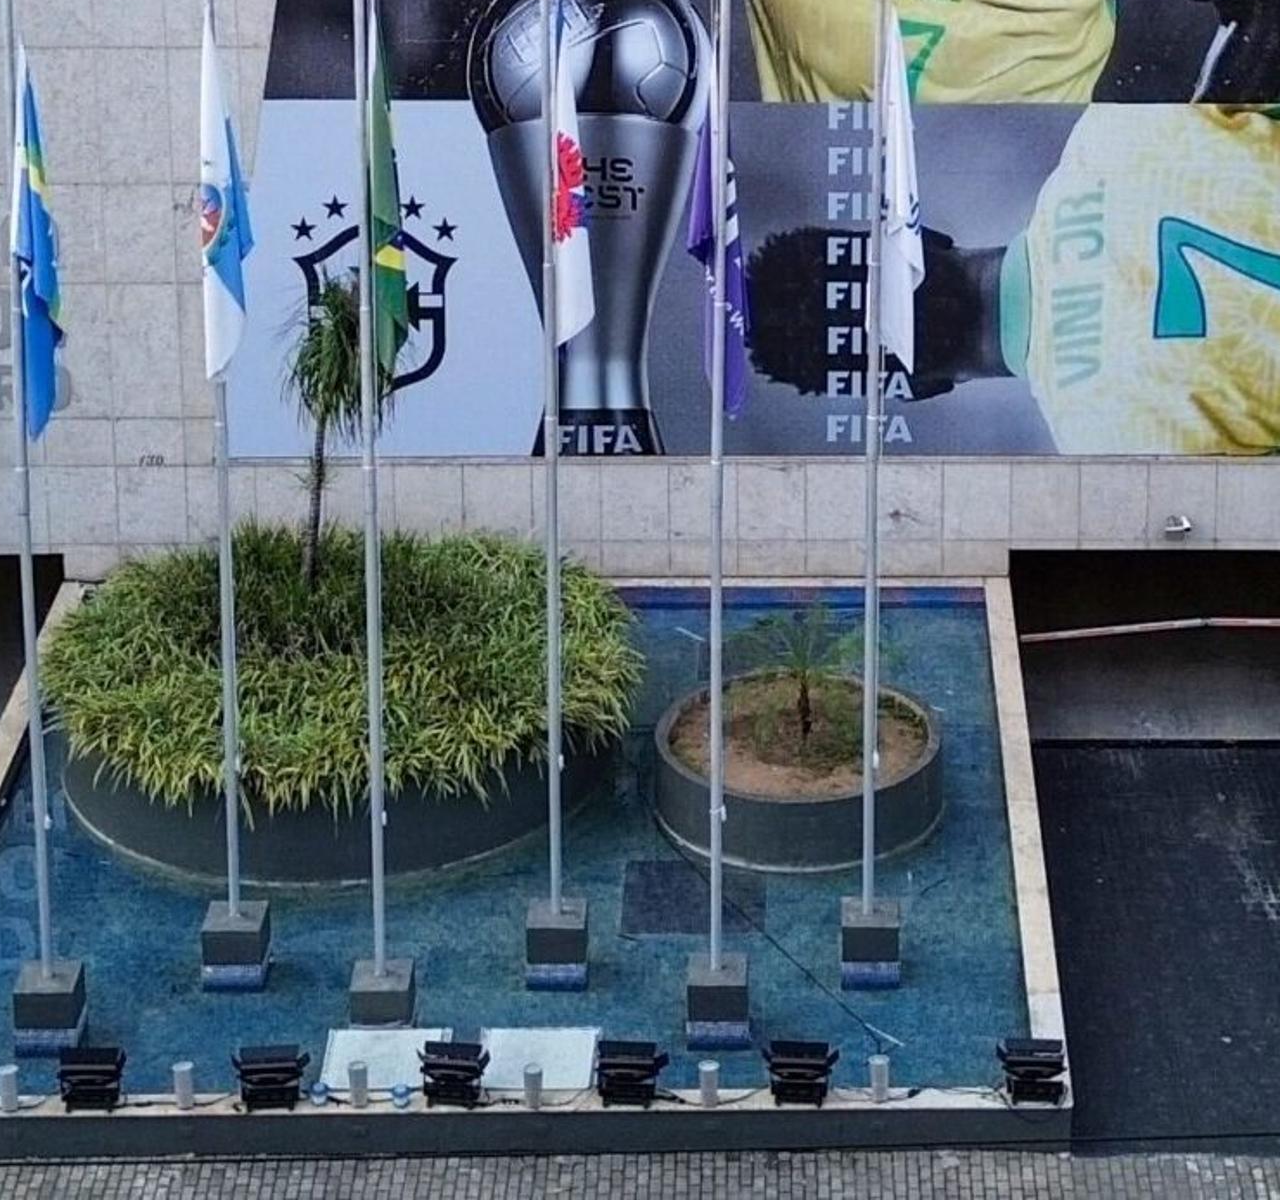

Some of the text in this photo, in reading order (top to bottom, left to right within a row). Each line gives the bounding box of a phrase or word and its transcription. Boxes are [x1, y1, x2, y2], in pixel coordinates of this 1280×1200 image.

[899, 18, 947, 102] 7
[828, 102, 872, 130] FI
[582, 157, 634, 182] HE
[828, 147, 872, 175] FI
[827, 192, 872, 221] FI
[826, 237, 870, 266] FI
[1051, 179, 1106, 389] VINI JR.
